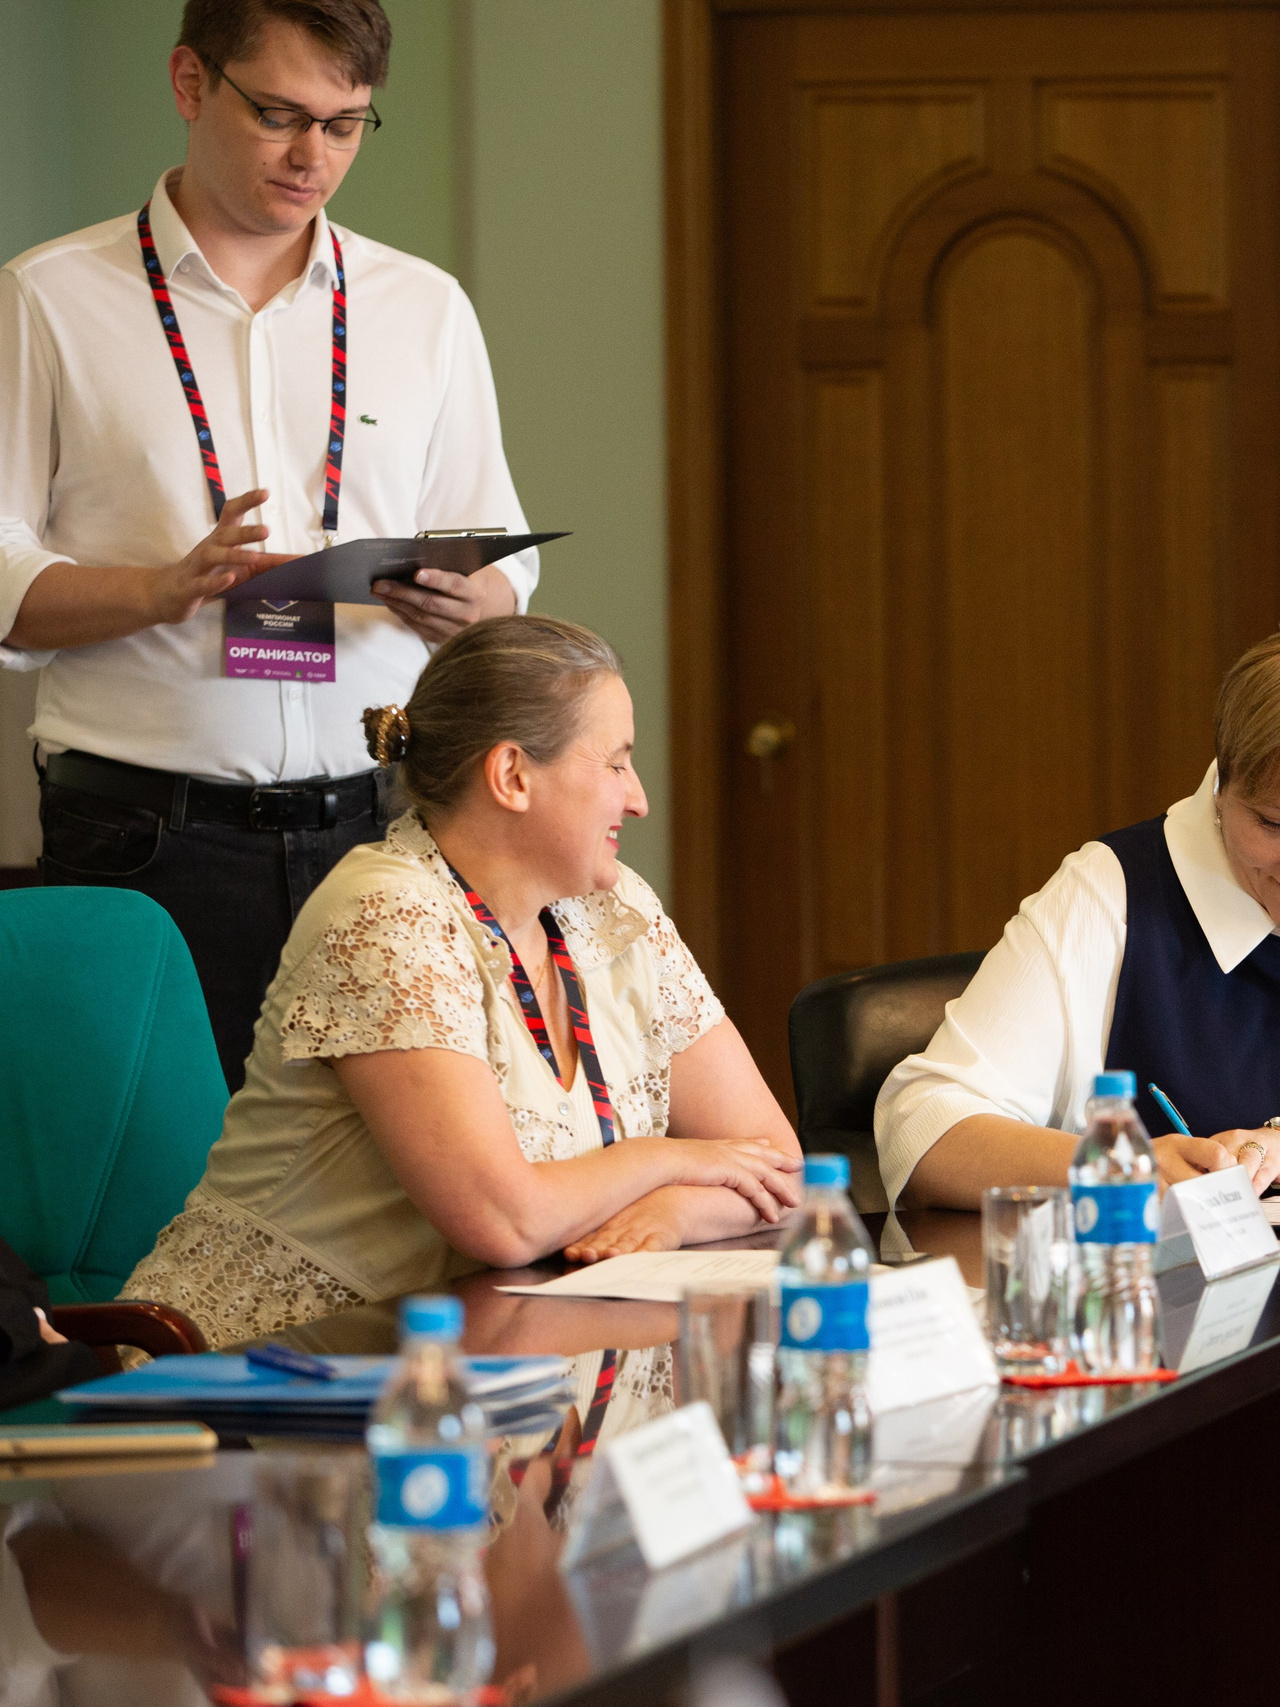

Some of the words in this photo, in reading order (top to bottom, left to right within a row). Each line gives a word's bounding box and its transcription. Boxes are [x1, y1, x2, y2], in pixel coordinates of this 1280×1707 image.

[256, 613, 301, 622] ЧЕМПИОНАТ
[263, 620, 294, 628] РОССИИ
[229, 646, 331, 663] ОРГАНИЗАТОР
